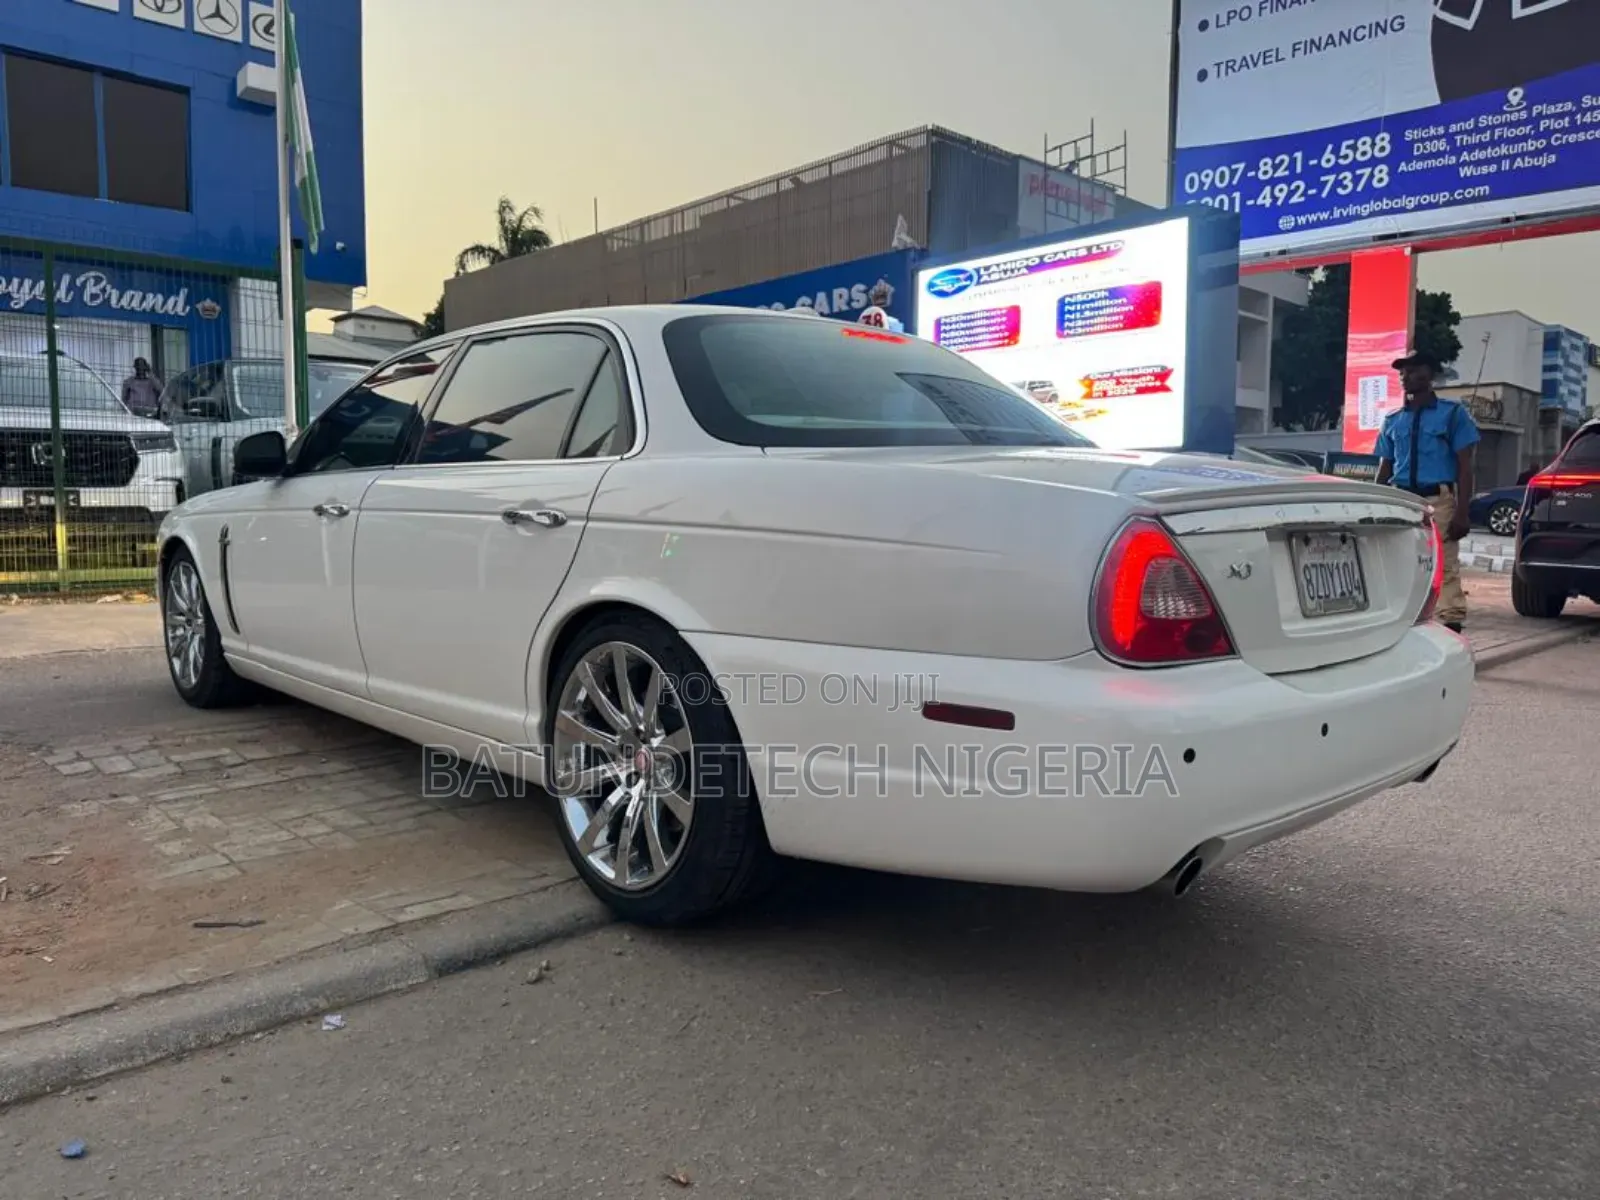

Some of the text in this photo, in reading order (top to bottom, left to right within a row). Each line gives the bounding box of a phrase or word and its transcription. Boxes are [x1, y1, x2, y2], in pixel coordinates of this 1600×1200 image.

[1215, 0, 1317, 29] LPO FINA
[1213, 14, 1405, 79] TRAVEL FINANCING
[1404, 125, 1445, 141] Sticks
[1448, 117, 1474, 133] and
[1478, 110, 1527, 127] Stones
[1531, 100, 1576, 117] Plaza,
[1413, 143, 1450, 156] D306,
[1454, 132, 1490, 147] Third
[1494, 125, 1535, 140] Floor,
[1539, 115, 1570, 132] Plot
[1184, 132, 1392, 194] 0907-821-6588
[1398, 157, 1456, 173] Ademola
[1459, 138, 1546, 164] Adetokunbo
[1458, 164, 1497, 178] Wuse
[1512, 153, 1556, 170] Abuja
[1184, 164, 1390, 213] 01-492-7378
[1296, 184, 1490, 226] www.irvinglobalgroup.com
[980, 240, 1124, 275] LAMIDO CARS LTD
[76, 271, 190, 317] Brand
